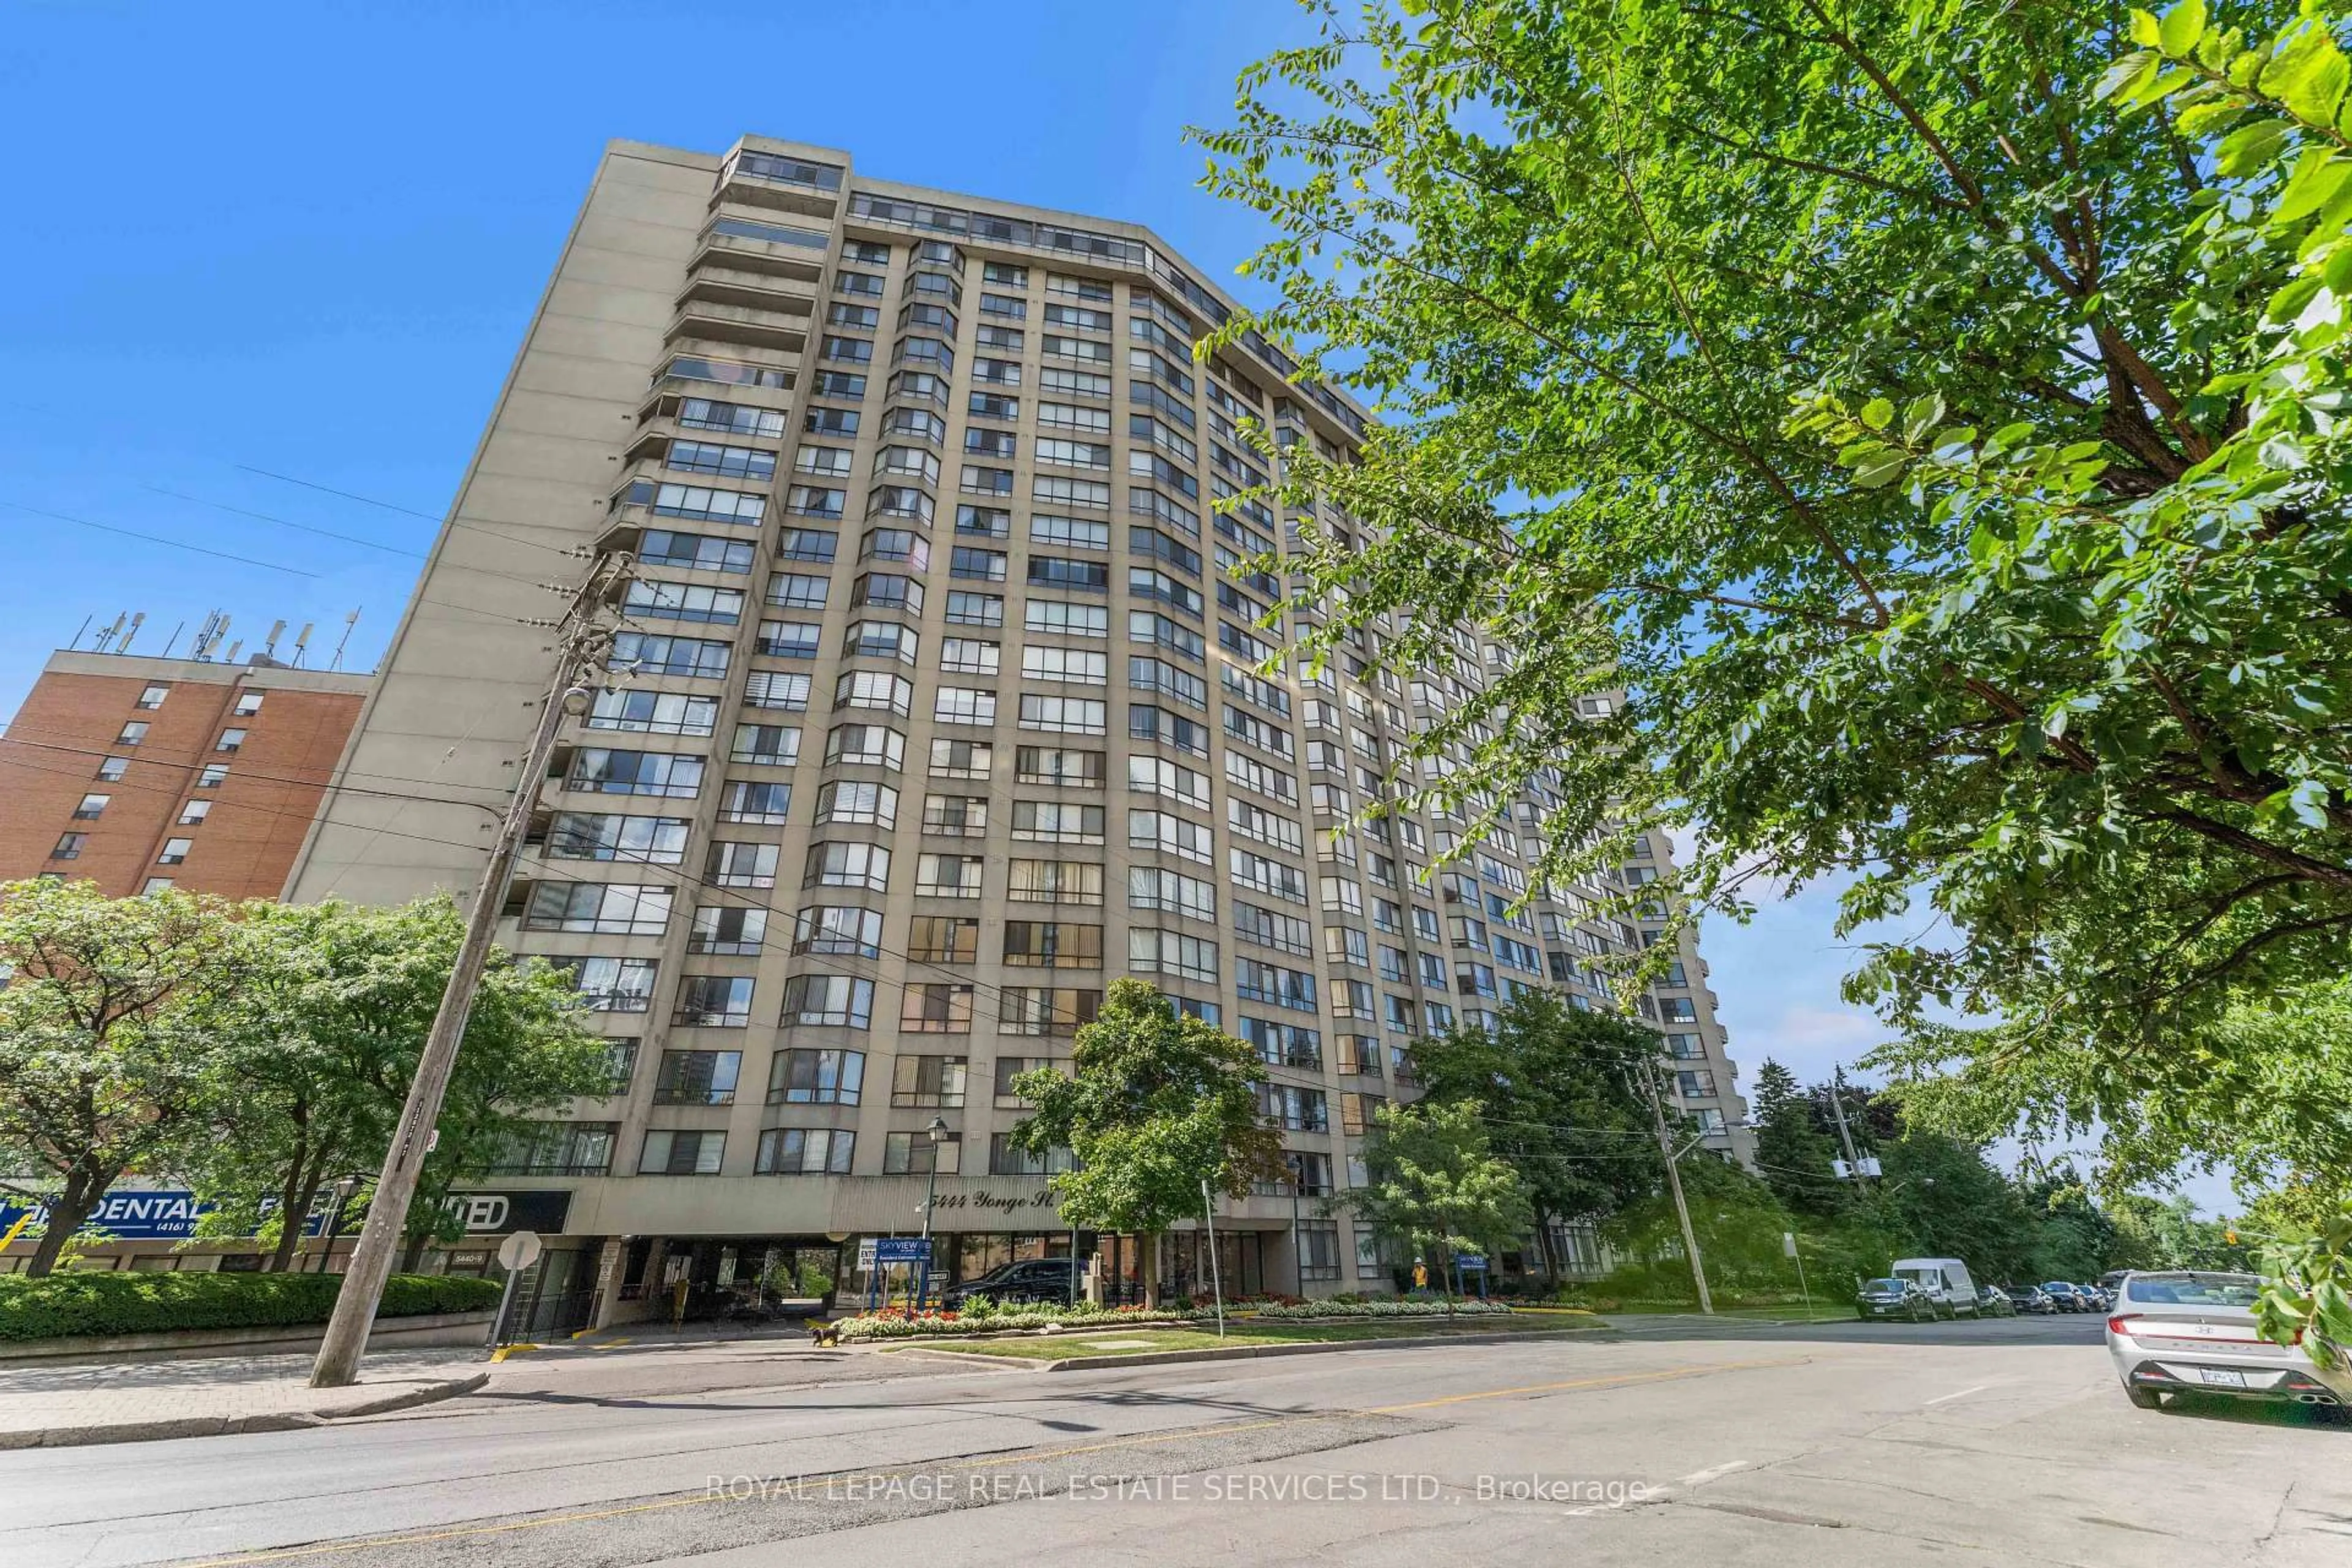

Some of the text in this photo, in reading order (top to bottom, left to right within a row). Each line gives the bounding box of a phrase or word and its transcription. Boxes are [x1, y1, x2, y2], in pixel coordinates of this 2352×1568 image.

[86, 1199, 202, 1219] DENTAL
[930, 1195, 967, 1208] 5444
[973, 1191, 1028, 1214] Yonge
[157, 1223, 184, 1231] (416)
[880, 1241, 918, 1250] SKYVIEW
